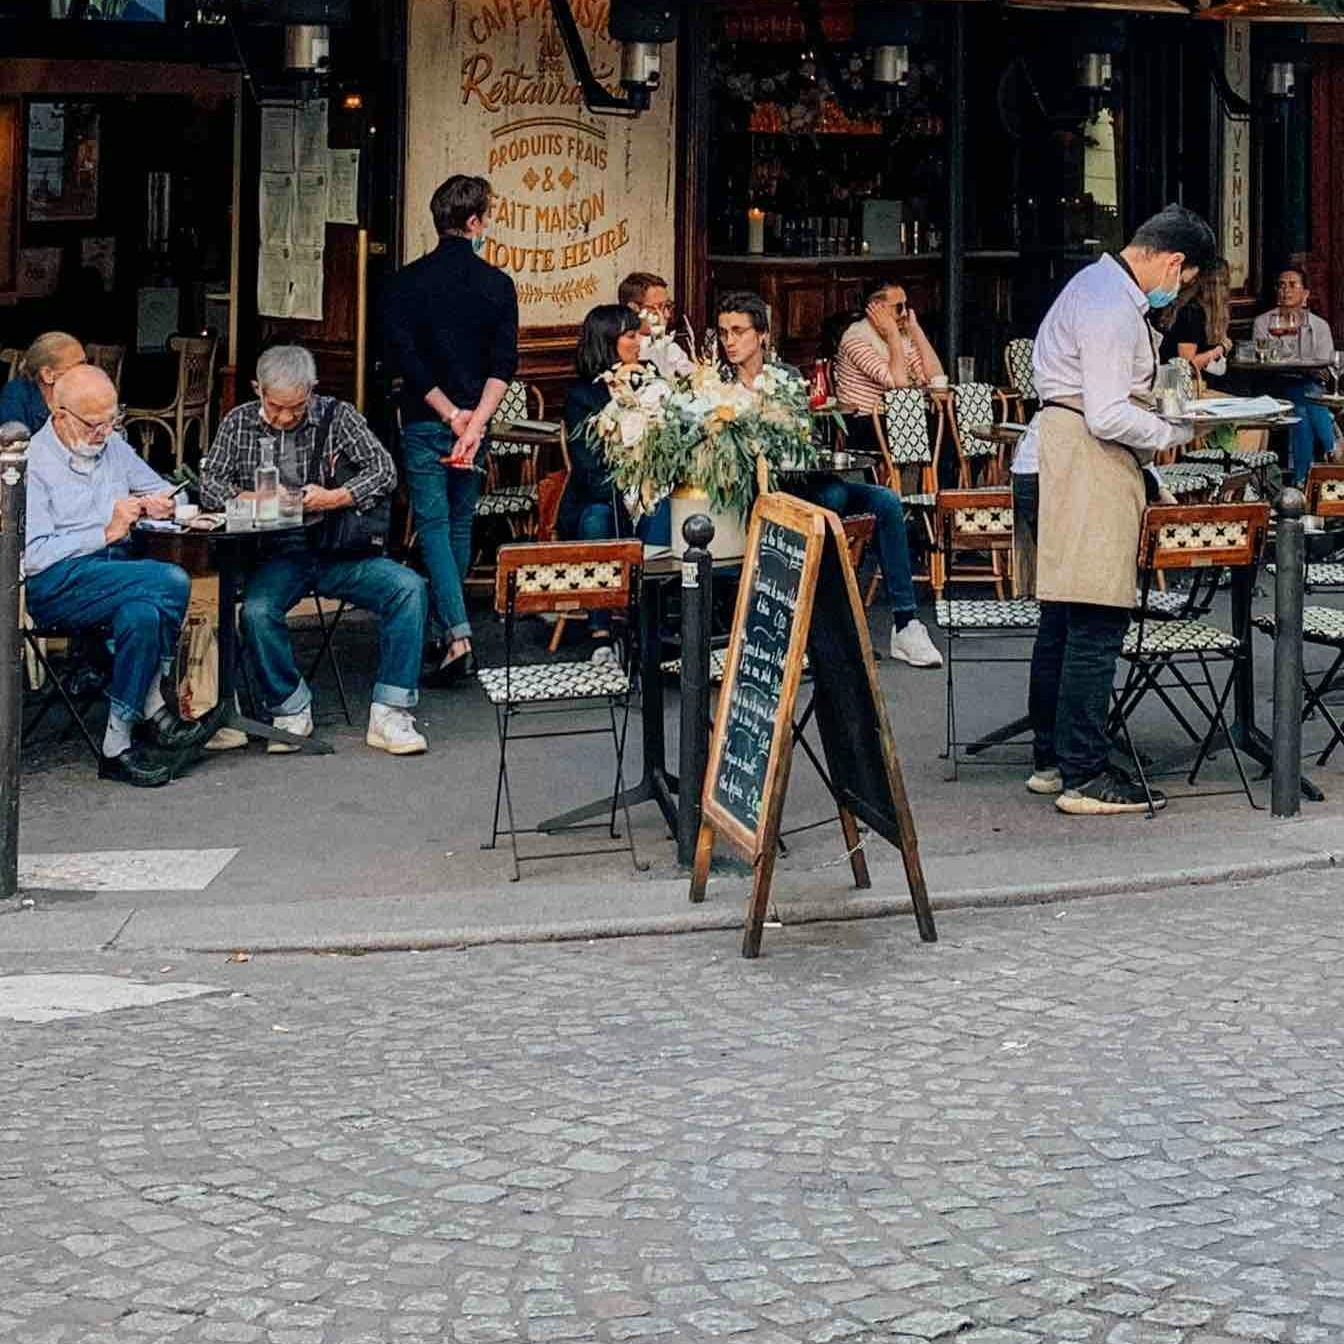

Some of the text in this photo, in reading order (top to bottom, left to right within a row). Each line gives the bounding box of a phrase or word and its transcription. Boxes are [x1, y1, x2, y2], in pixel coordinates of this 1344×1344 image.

[488, 133, 608, 175] PRODUITS FRAIS
[542, 165, 554, 192] &
[535, 188, 606, 234] MAISON
[484, 217, 630, 273] TOUTE HEURE
